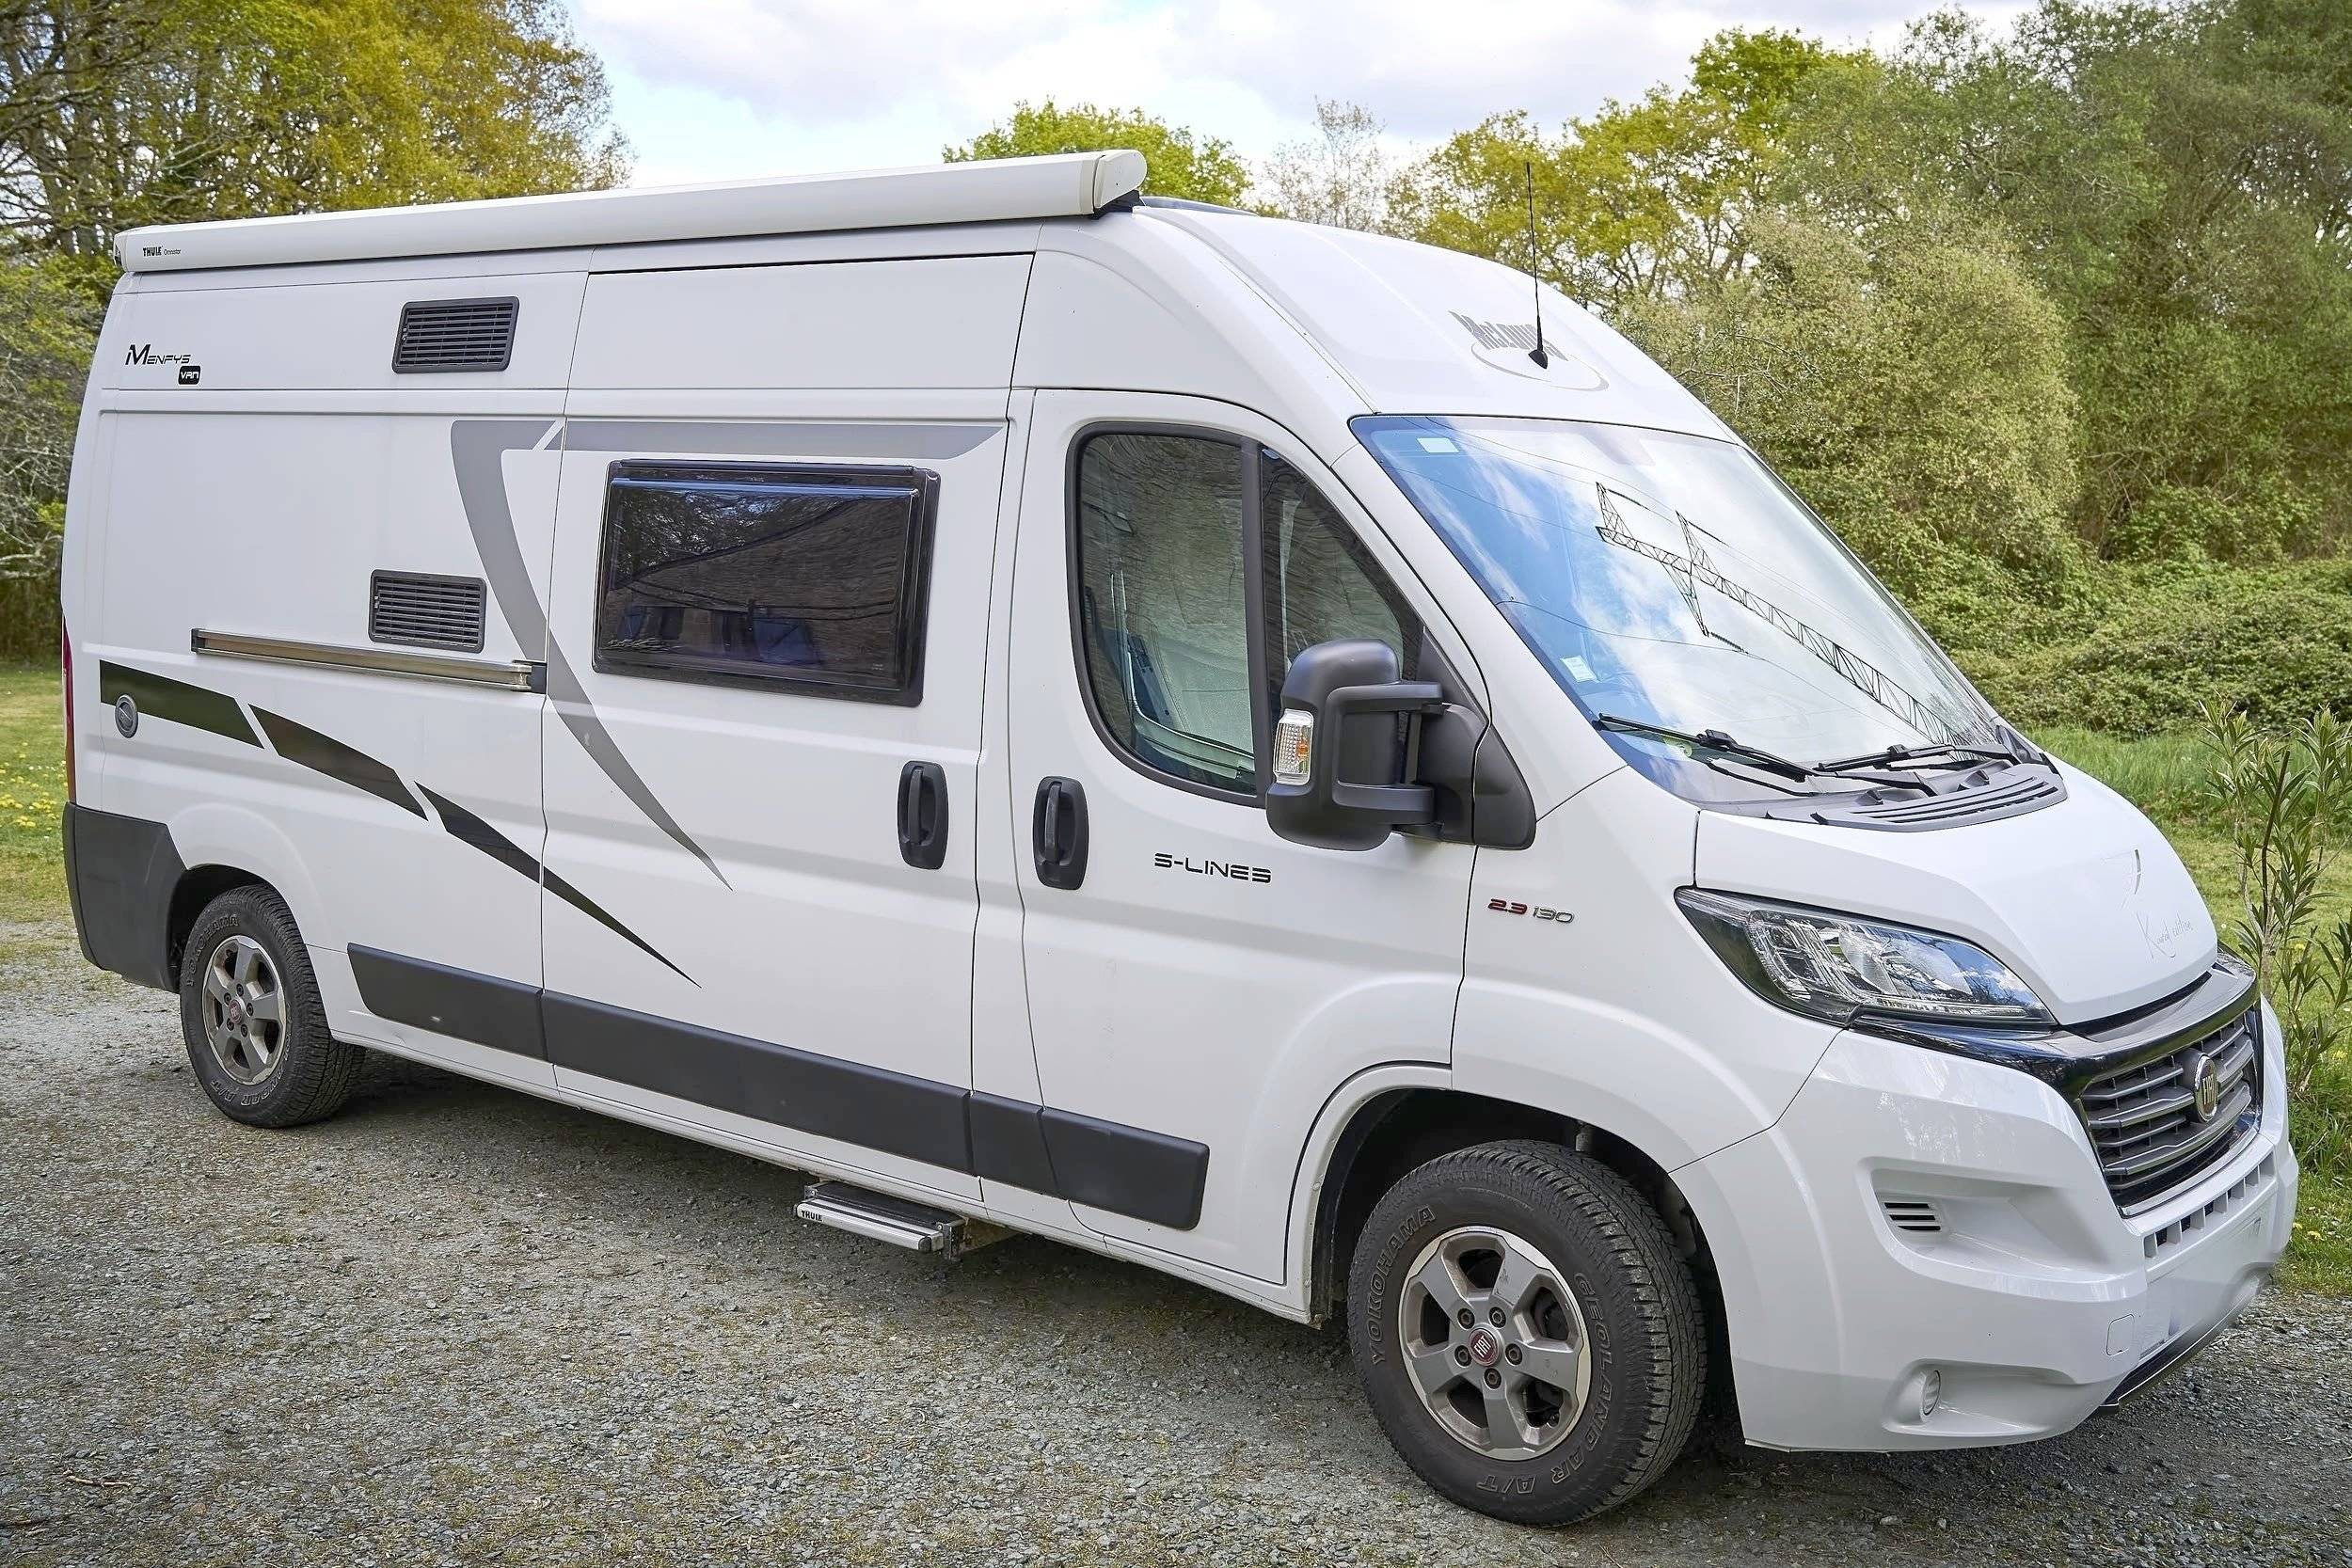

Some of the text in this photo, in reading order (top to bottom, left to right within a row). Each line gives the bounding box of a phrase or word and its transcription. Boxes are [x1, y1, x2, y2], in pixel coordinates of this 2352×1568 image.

[142, 245, 162, 257] THULE
[1153, 852, 1272, 884] S-LINES
[1533, 906, 1575, 924] 130
[801, 1210, 824, 1222] THULE
[1367, 1205, 1437, 1365] YOKOHAMA
[1473, 1335, 1492, 1358] FIAT
[1476, 1272, 1613, 1494] GEOLANDAR A/T
